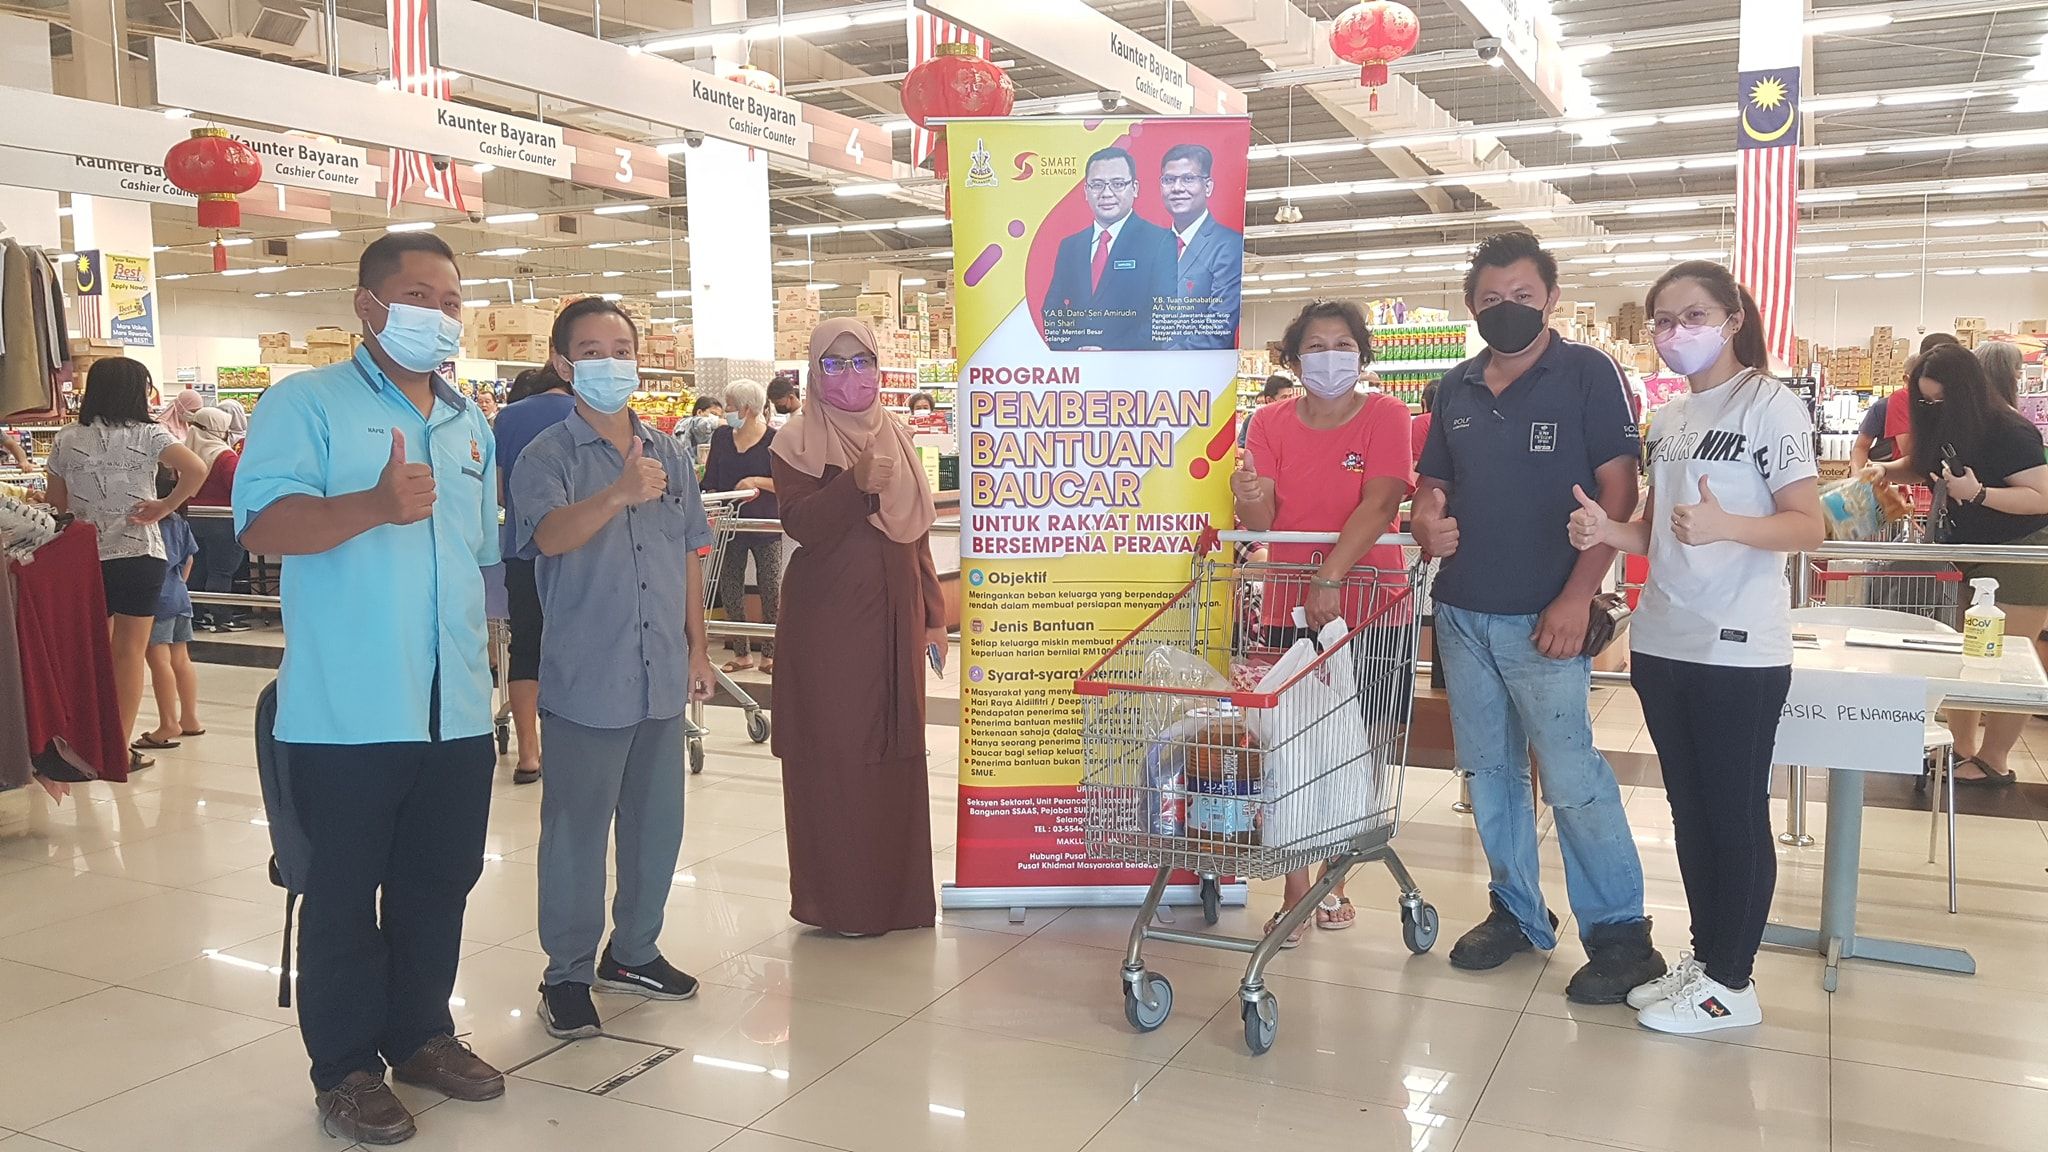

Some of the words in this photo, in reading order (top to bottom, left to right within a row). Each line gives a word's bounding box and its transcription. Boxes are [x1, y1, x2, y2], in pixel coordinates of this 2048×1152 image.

[1110, 32, 1148, 69] Kaunter
[1150, 53, 1182, 88] Bayaran
[1136, 76, 1159, 98] Cashier
[1160, 88, 1182, 110] Counter
[692, 79, 744, 111] Kaunter
[747, 96, 796, 126] Bayaran
[437, 108, 497, 135] Kaunter
[500, 122, 557, 148] Bayaran
[729, 117, 762, 136] Cashier
[763, 126, 796, 146] Counter
[229, 134, 295, 158] Kaunter
[299, 144, 359, 170] Bayaran
[845, 127, 864, 165] 4
[479, 141, 517, 159] Cashier
[518, 149, 557, 168] Counter
[1040, 156, 1076, 167] SMART
[614, 148, 634, 183] 3
[275, 162, 316, 179] Cashier
[317, 169, 359, 186] Counter
[120, 178, 161, 194] Cashier
[114, 263, 142, 277] Best
[970, 367, 1080, 385] PROGRAM
[970, 391, 1210, 427] PEMBERIAN
[971, 431, 1173, 468] BANTUAN
[1654, 432, 1699, 463] AIR
[1692, 430, 1747, 462] NIKE
[1818, 468, 1846, 476] Protex
[971, 472, 1141, 508] BAUCAR
[972, 514, 1040, 532] UNTUK
[1048, 514, 1130, 532] RAKYAT
[1136, 513, 1209, 532] MISKIN
[972, 536, 1107, 554] BERSEMPENA
[1114, 536, 1221, 553] PERAYAN
[988, 572, 1048, 586] Objektif
[969, 591, 1025, 601] Meringankan
[1027, 590, 1056, 598] beban
[1058, 590, 1098, 600] keluarga
[1100, 592, 1122, 600] yang
[969, 601, 998, 610] rendah
[1001, 601, 1030, 609] dalam
[1032, 600, 1074, 608] membuat
[1076, 601, 1122, 610] persiapan
[990, 620, 1030, 633] Jenis
[1033, 619, 1094, 632] Bantuan
[971, 638, 998, 648] Setiap
[1000, 638, 1040, 648] keluarga
[1041, 638, 1070, 646] miskin
[1072, 637, 1114, 646] membuat
[971, 648, 1014, 658] keperluan
[1016, 648, 1046, 656] harian
[1047, 648, 1081, 656] bernilai
[988, 668, 1083, 682] Syarat-syarat
[971, 688, 1021, 696] Masyarakat
[971, 709, 1024, 717] Pendapatan
[1027, 709, 1068, 717] penerima
[1782, 703, 1827, 720] ASIR
[1837, 704, 1926, 723] PENAMBANG
[1020, 728, 1050, 737] sahaja
[971, 738, 998, 748] Hanya
[1001, 739, 1036, 748] seorang
[1038, 738, 1080, 746] penerima
[1004, 748, 1024, 756] bagi
[1027, 748, 1054, 756] setiap
[971, 758, 1012, 766] Penerima
[967, 798, 998, 806] Seksyen
[1000, 798, 1035, 806] Sektoral,
[970, 807, 1010, 816] Bangunan
[1012, 808, 1038, 816] SSAAS,
[1040, 806, 1072, 816] Pejabat
[1034, 826, 1048, 834] TEL
[1030, 852, 1063, 861] Hubungi
[1065, 852, 1086, 860] Pusat
[1018, 862, 1040, 870] Pusat
[1042, 862, 1076, 870] Khidmat
[1076, 862, 1124, 870] Masyarakat
